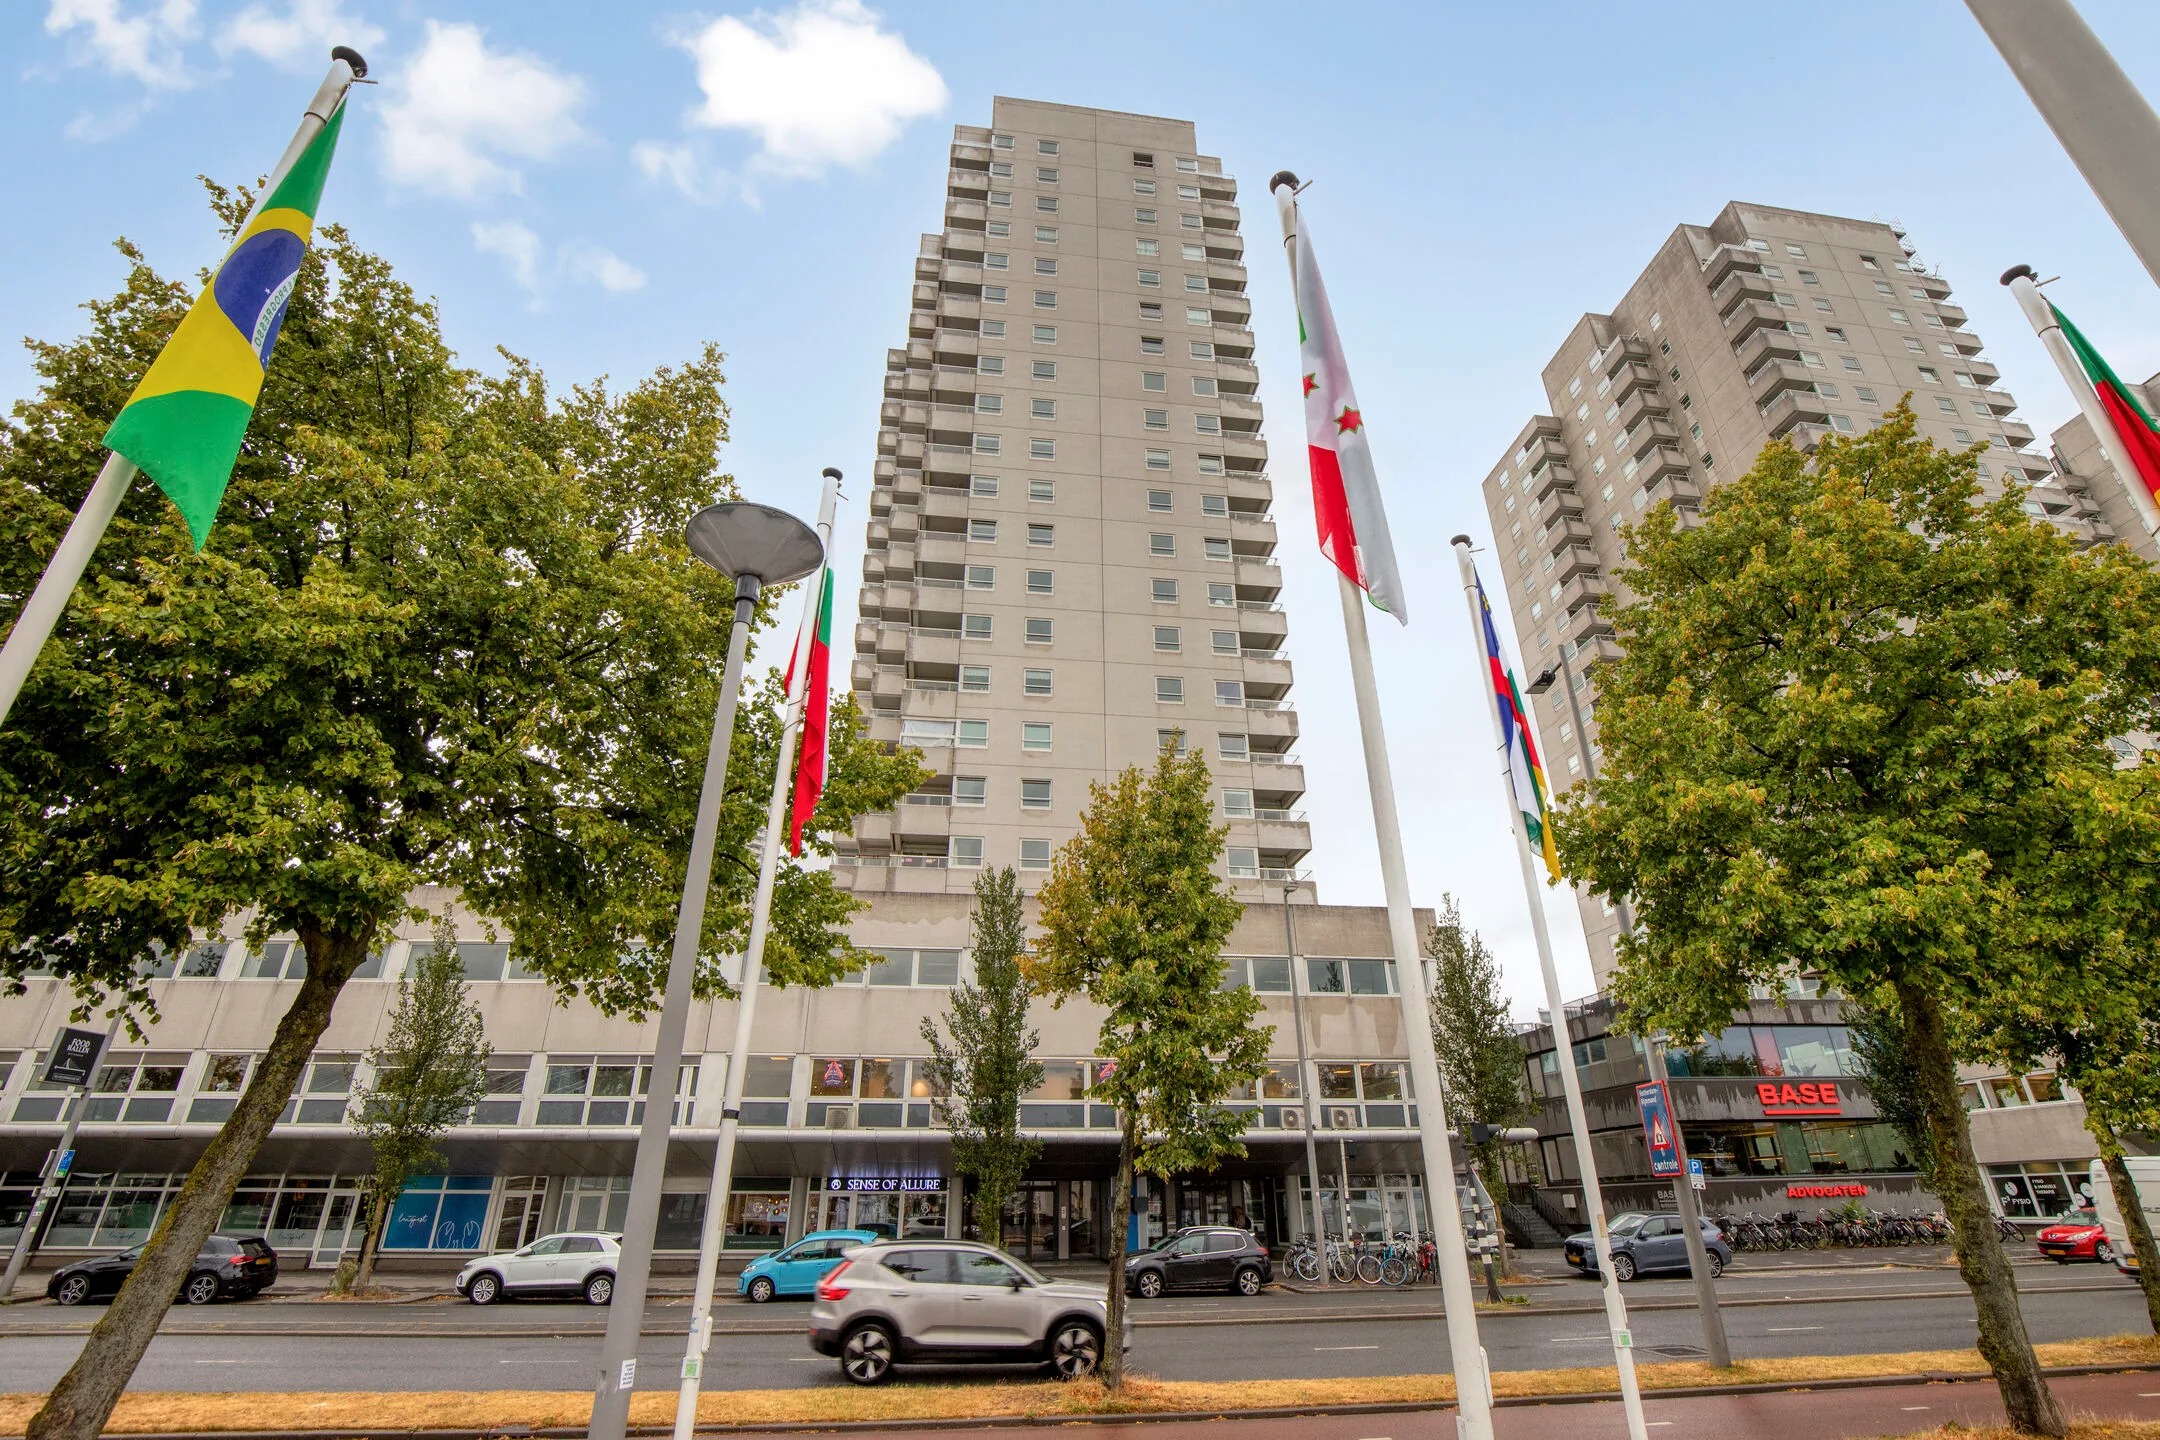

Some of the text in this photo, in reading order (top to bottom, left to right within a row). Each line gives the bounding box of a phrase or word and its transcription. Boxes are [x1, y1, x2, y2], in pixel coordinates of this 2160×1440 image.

[71, 1038, 91, 1047] FOOD
[1756, 1083, 1840, 1104] BASE
[1653, 1159, 1679, 1171] controle
[1691, 1161, 1699, 1173] P
[847, 1179, 941, 1190] SENSE OF ALLURE
[1657, 1190, 1675, 1199] BAS
[1787, 1184, 1869, 1198] ADVOCATEN
